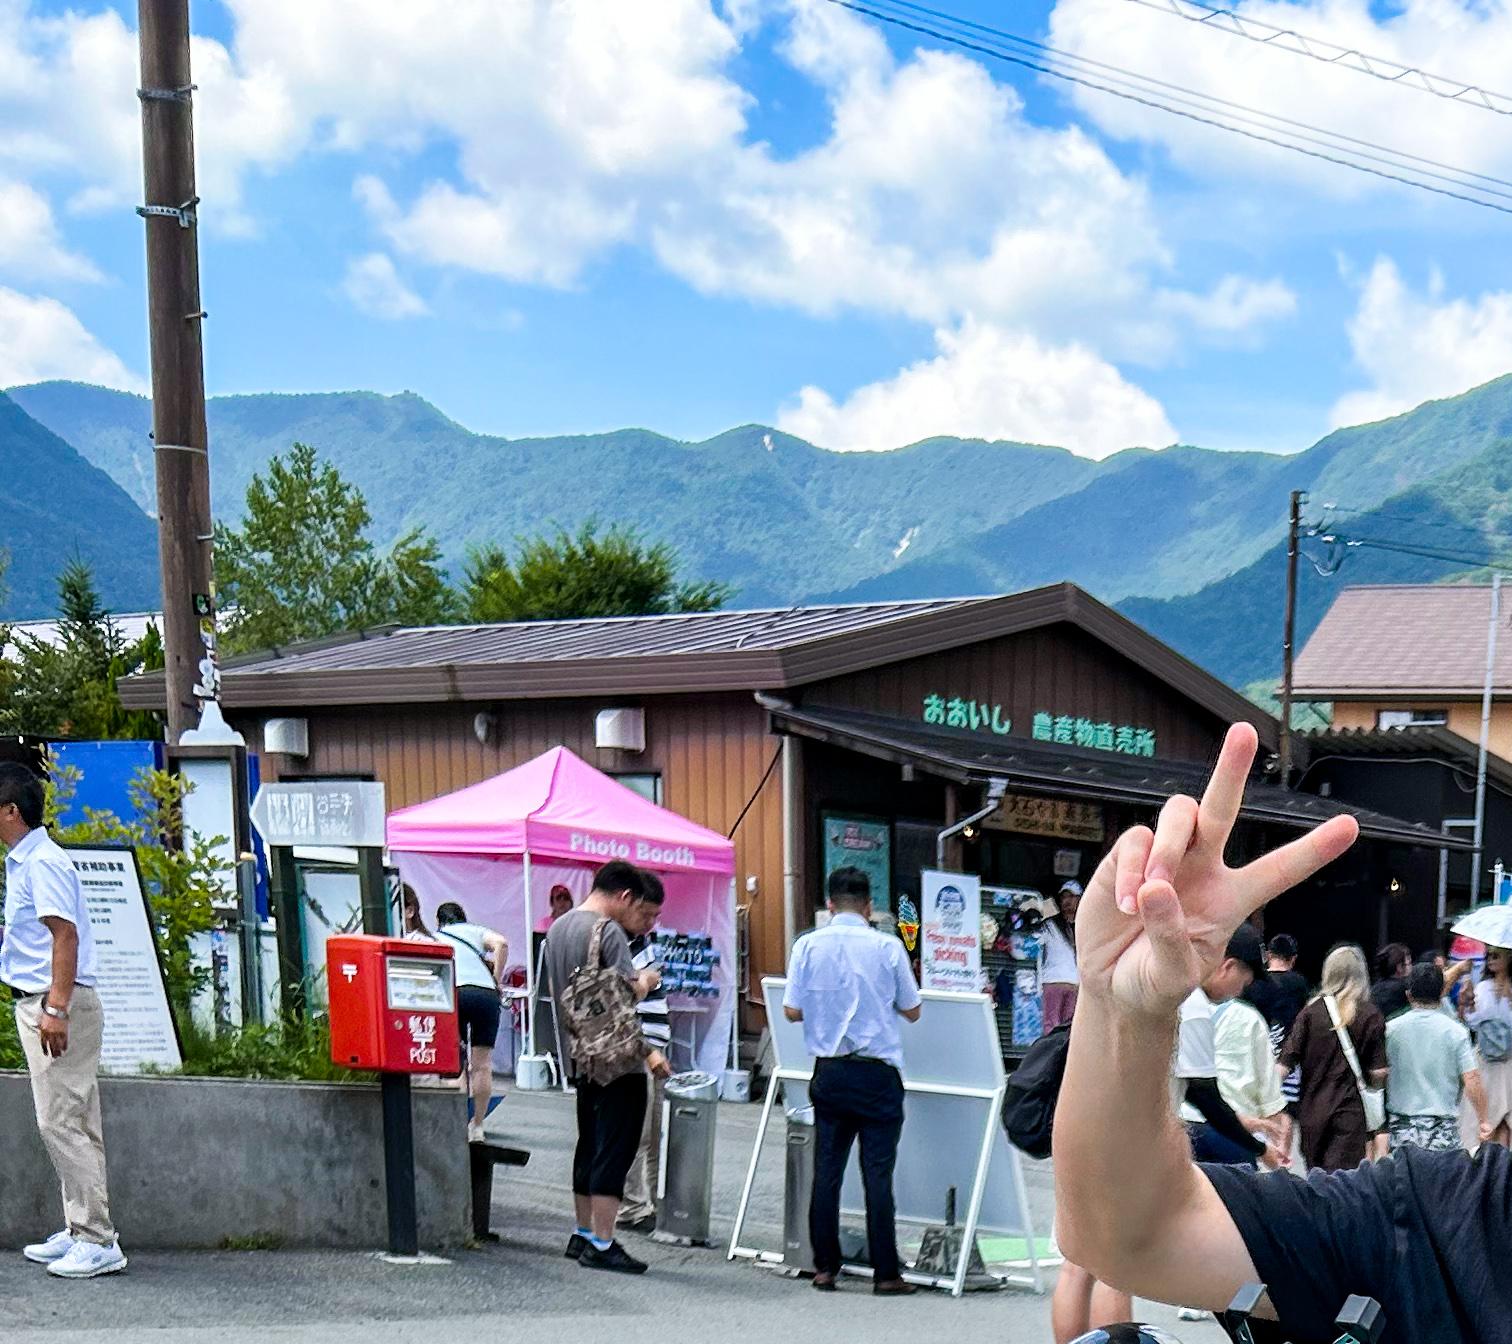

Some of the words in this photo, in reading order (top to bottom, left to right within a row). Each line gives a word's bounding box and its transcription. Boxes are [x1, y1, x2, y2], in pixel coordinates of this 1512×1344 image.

[923, 693, 1011, 735] おおいし
[1032, 711, 1156, 758] 農産物直売所
[570, 833, 630, 859] Photo
[636, 842, 695, 866] Booth
[409, 1047, 437, 1064] POST
